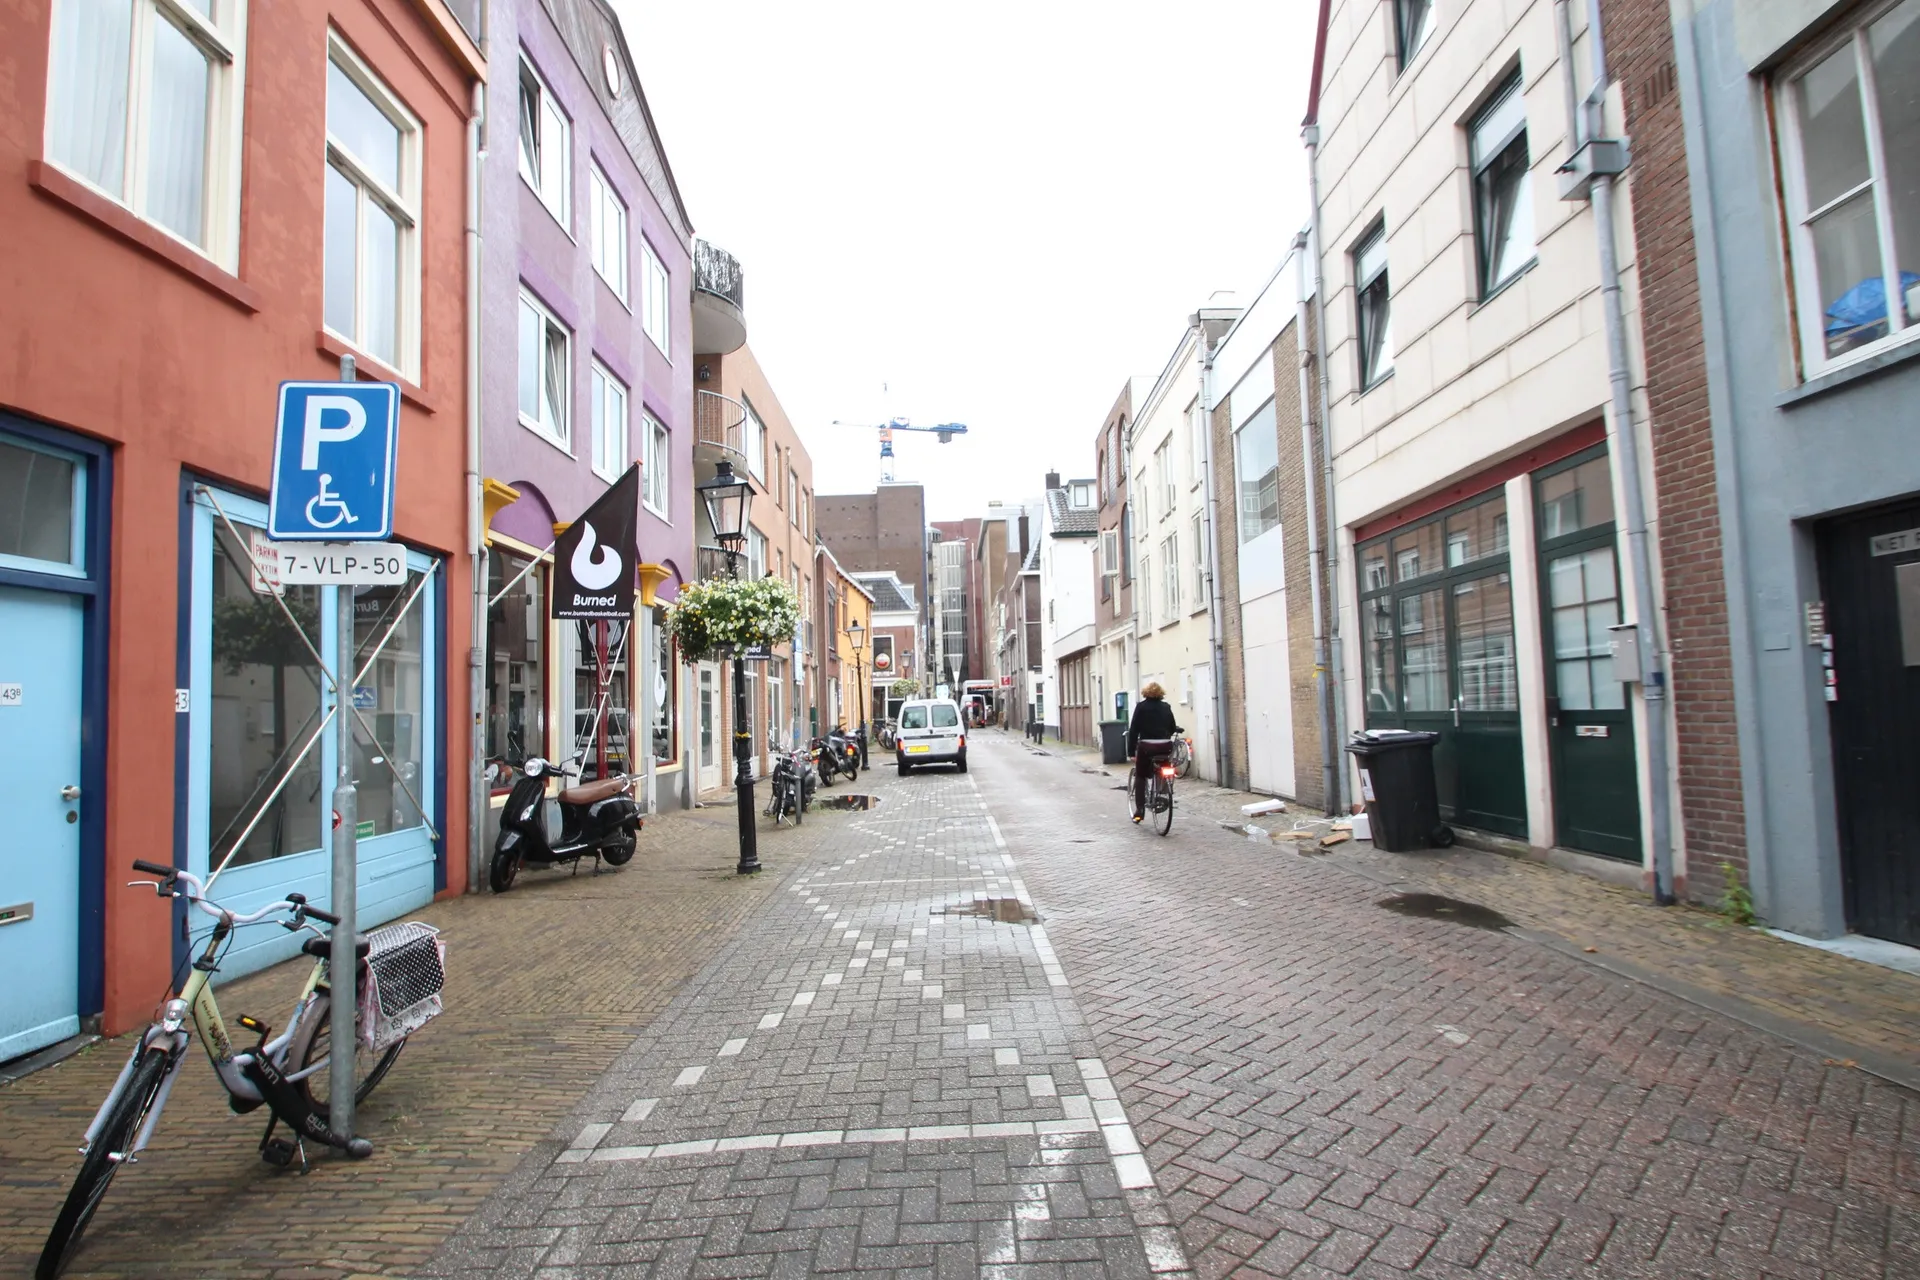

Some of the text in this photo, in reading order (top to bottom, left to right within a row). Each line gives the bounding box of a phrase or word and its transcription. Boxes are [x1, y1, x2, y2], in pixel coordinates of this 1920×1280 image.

[301, 395, 367, 470] P
[255, 544, 278, 561] PARKIN
[284, 556, 400, 575] 7-VLP-50
[573, 594, 617, 607] Burned
[2, 688, 22, 700] 43B
